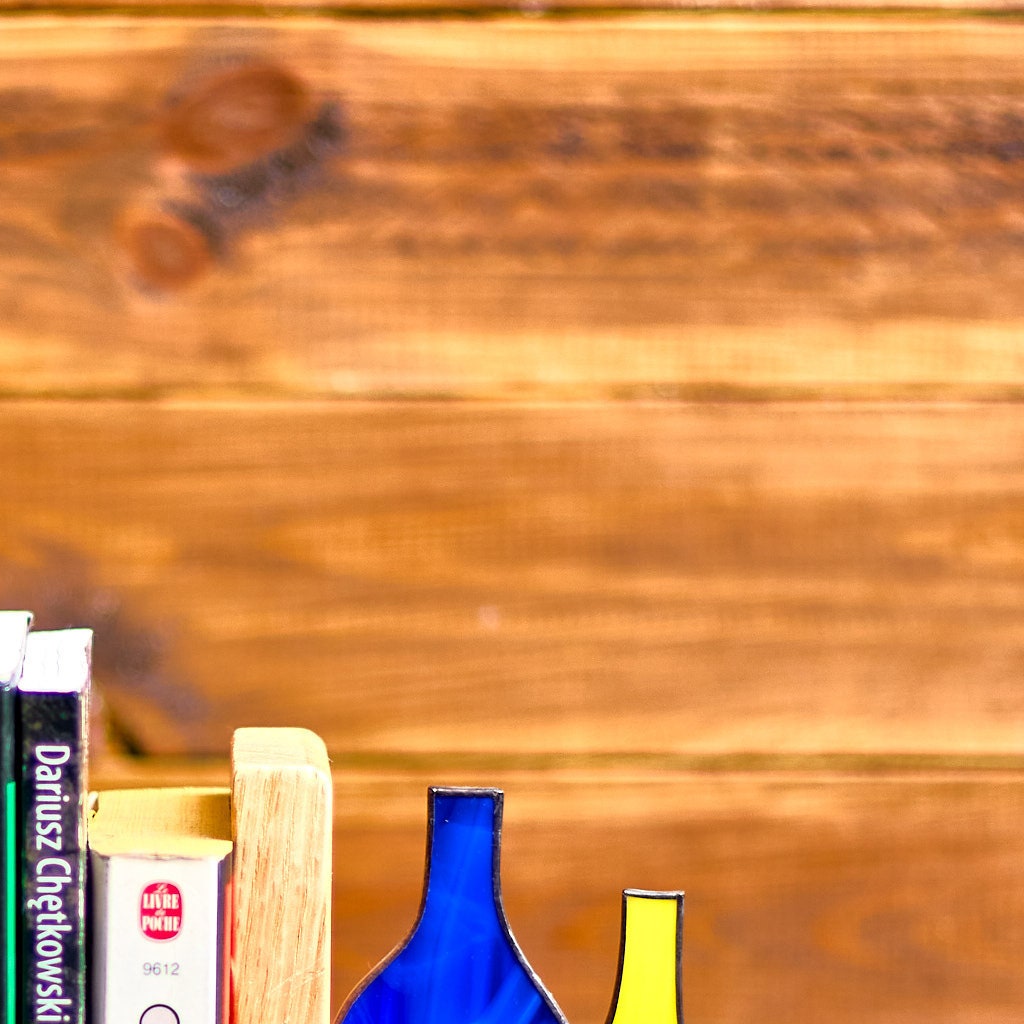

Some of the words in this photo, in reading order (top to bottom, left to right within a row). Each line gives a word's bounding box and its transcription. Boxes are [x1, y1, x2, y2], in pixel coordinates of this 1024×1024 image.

[34, 744, 71, 851] Dariusz
[142, 893, 180, 909] LIVRE
[141, 915, 181, 932] POCHE
[27, 857, 71, 1022] Chętkowski
[142, 961, 181, 976] 9612
